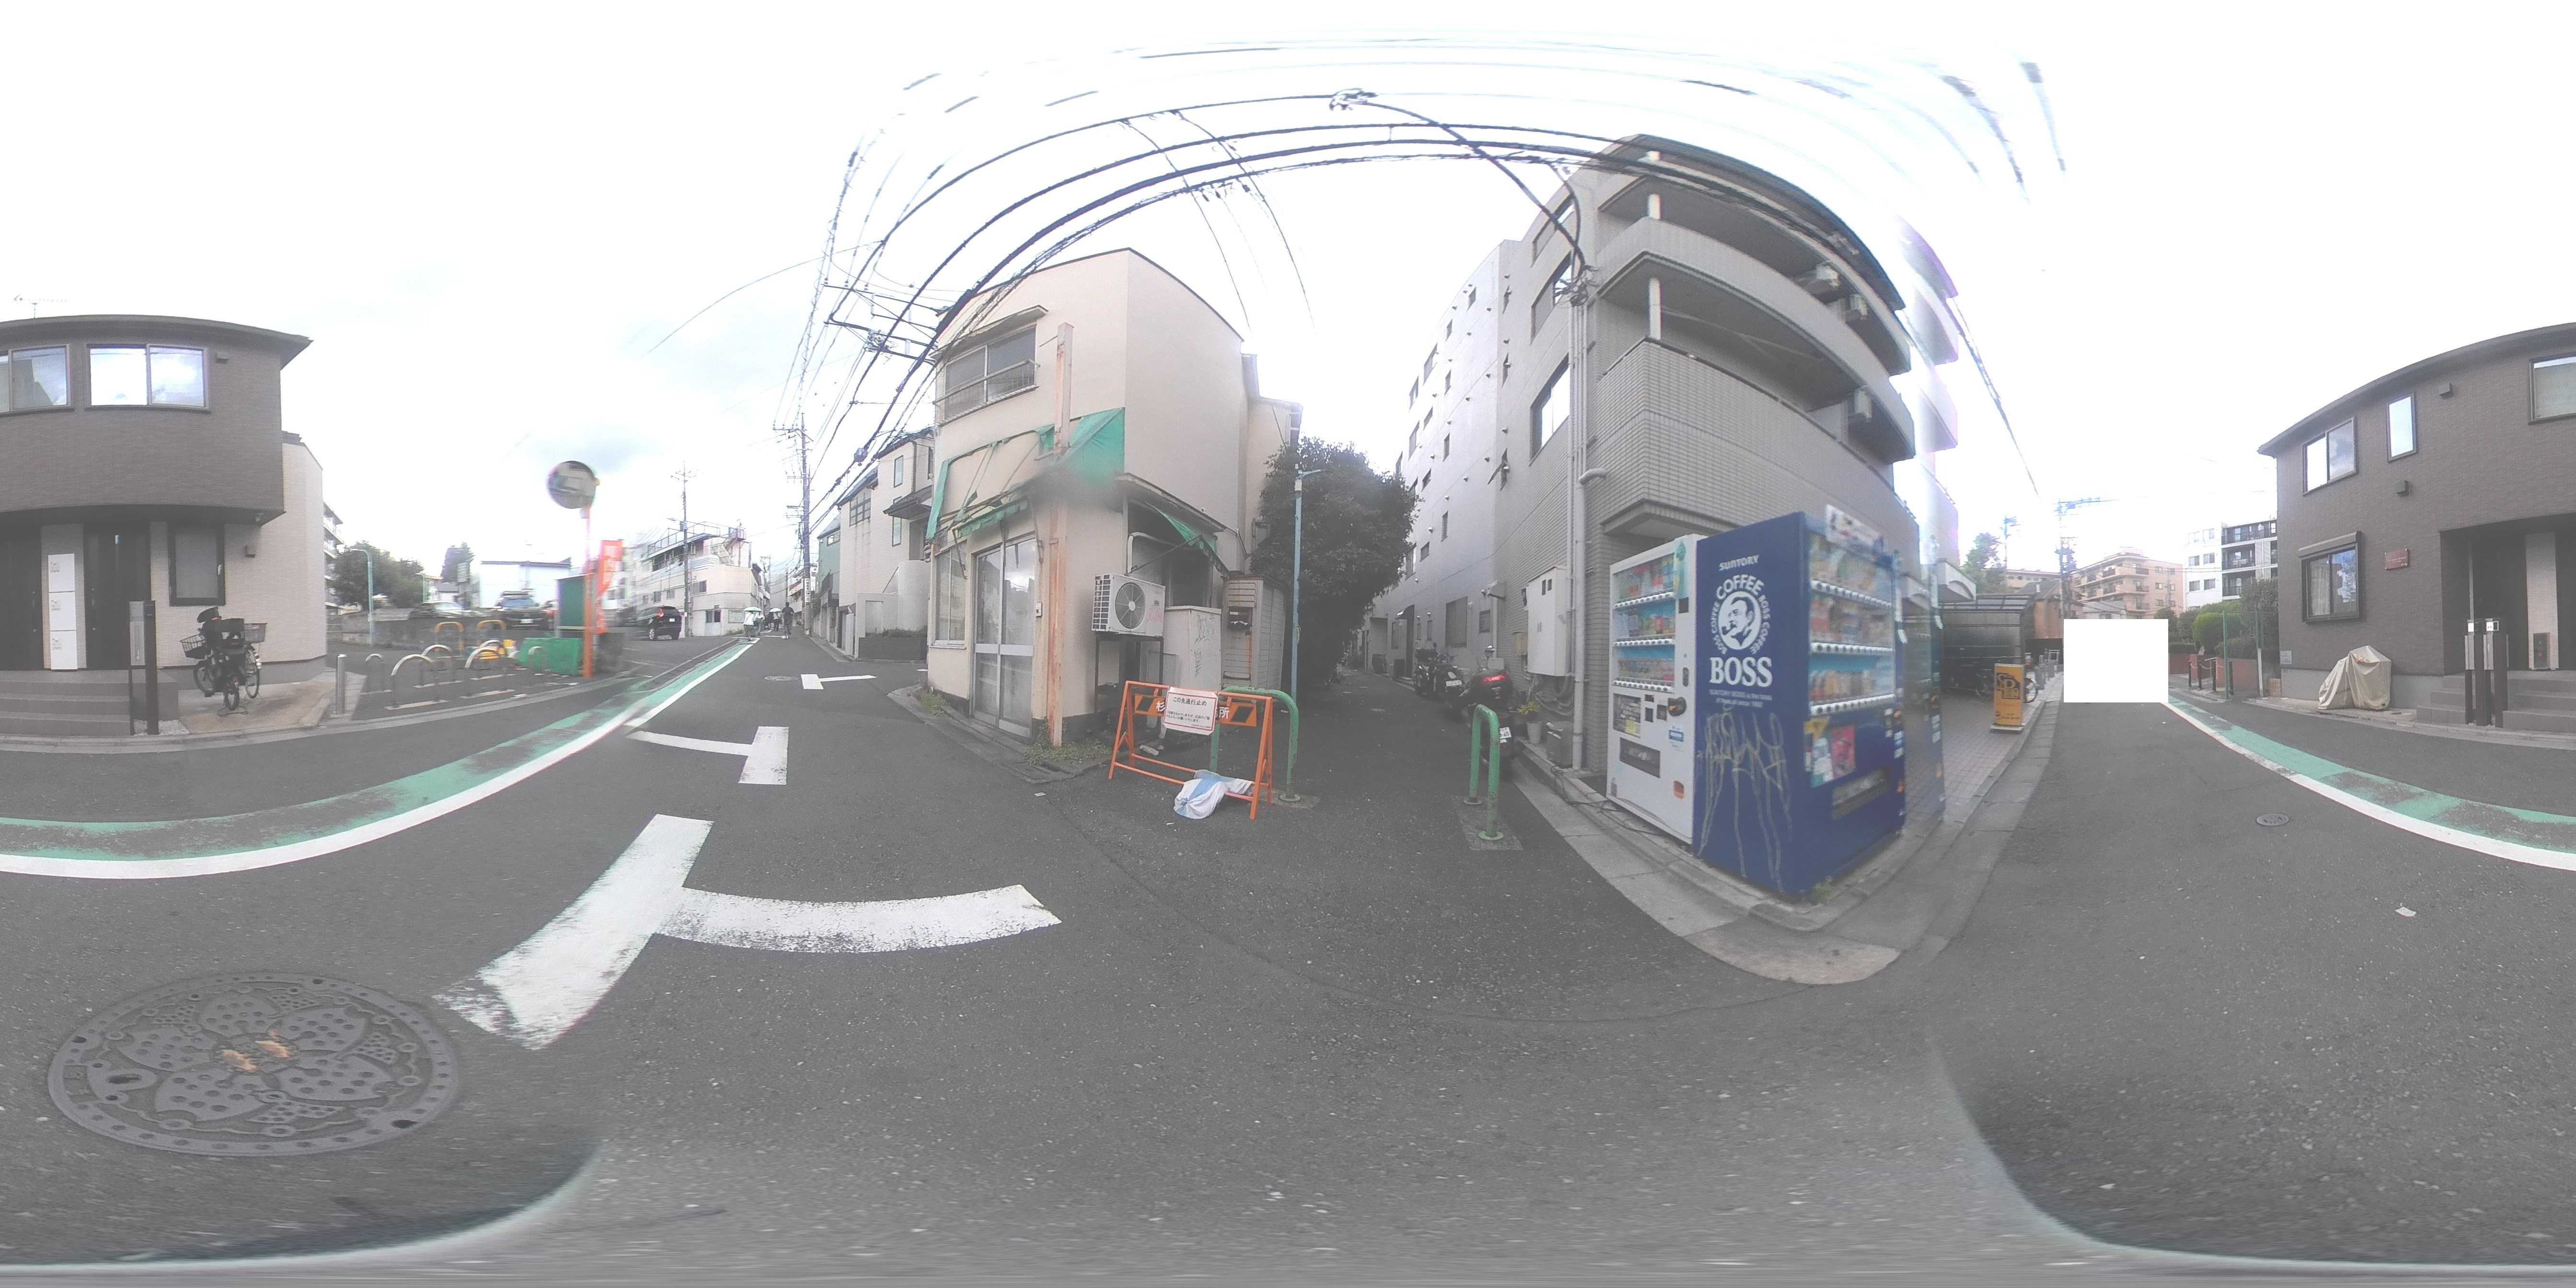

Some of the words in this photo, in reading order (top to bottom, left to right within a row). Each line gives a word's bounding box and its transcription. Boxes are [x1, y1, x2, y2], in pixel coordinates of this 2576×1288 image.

[1719, 554, 1759, 571] SUNTORY
[1716, 574, 1765, 599] COFFEE
[1709, 656, 1773, 687] BOSS
[1173, 697, 1207, 706] この先通行止め
